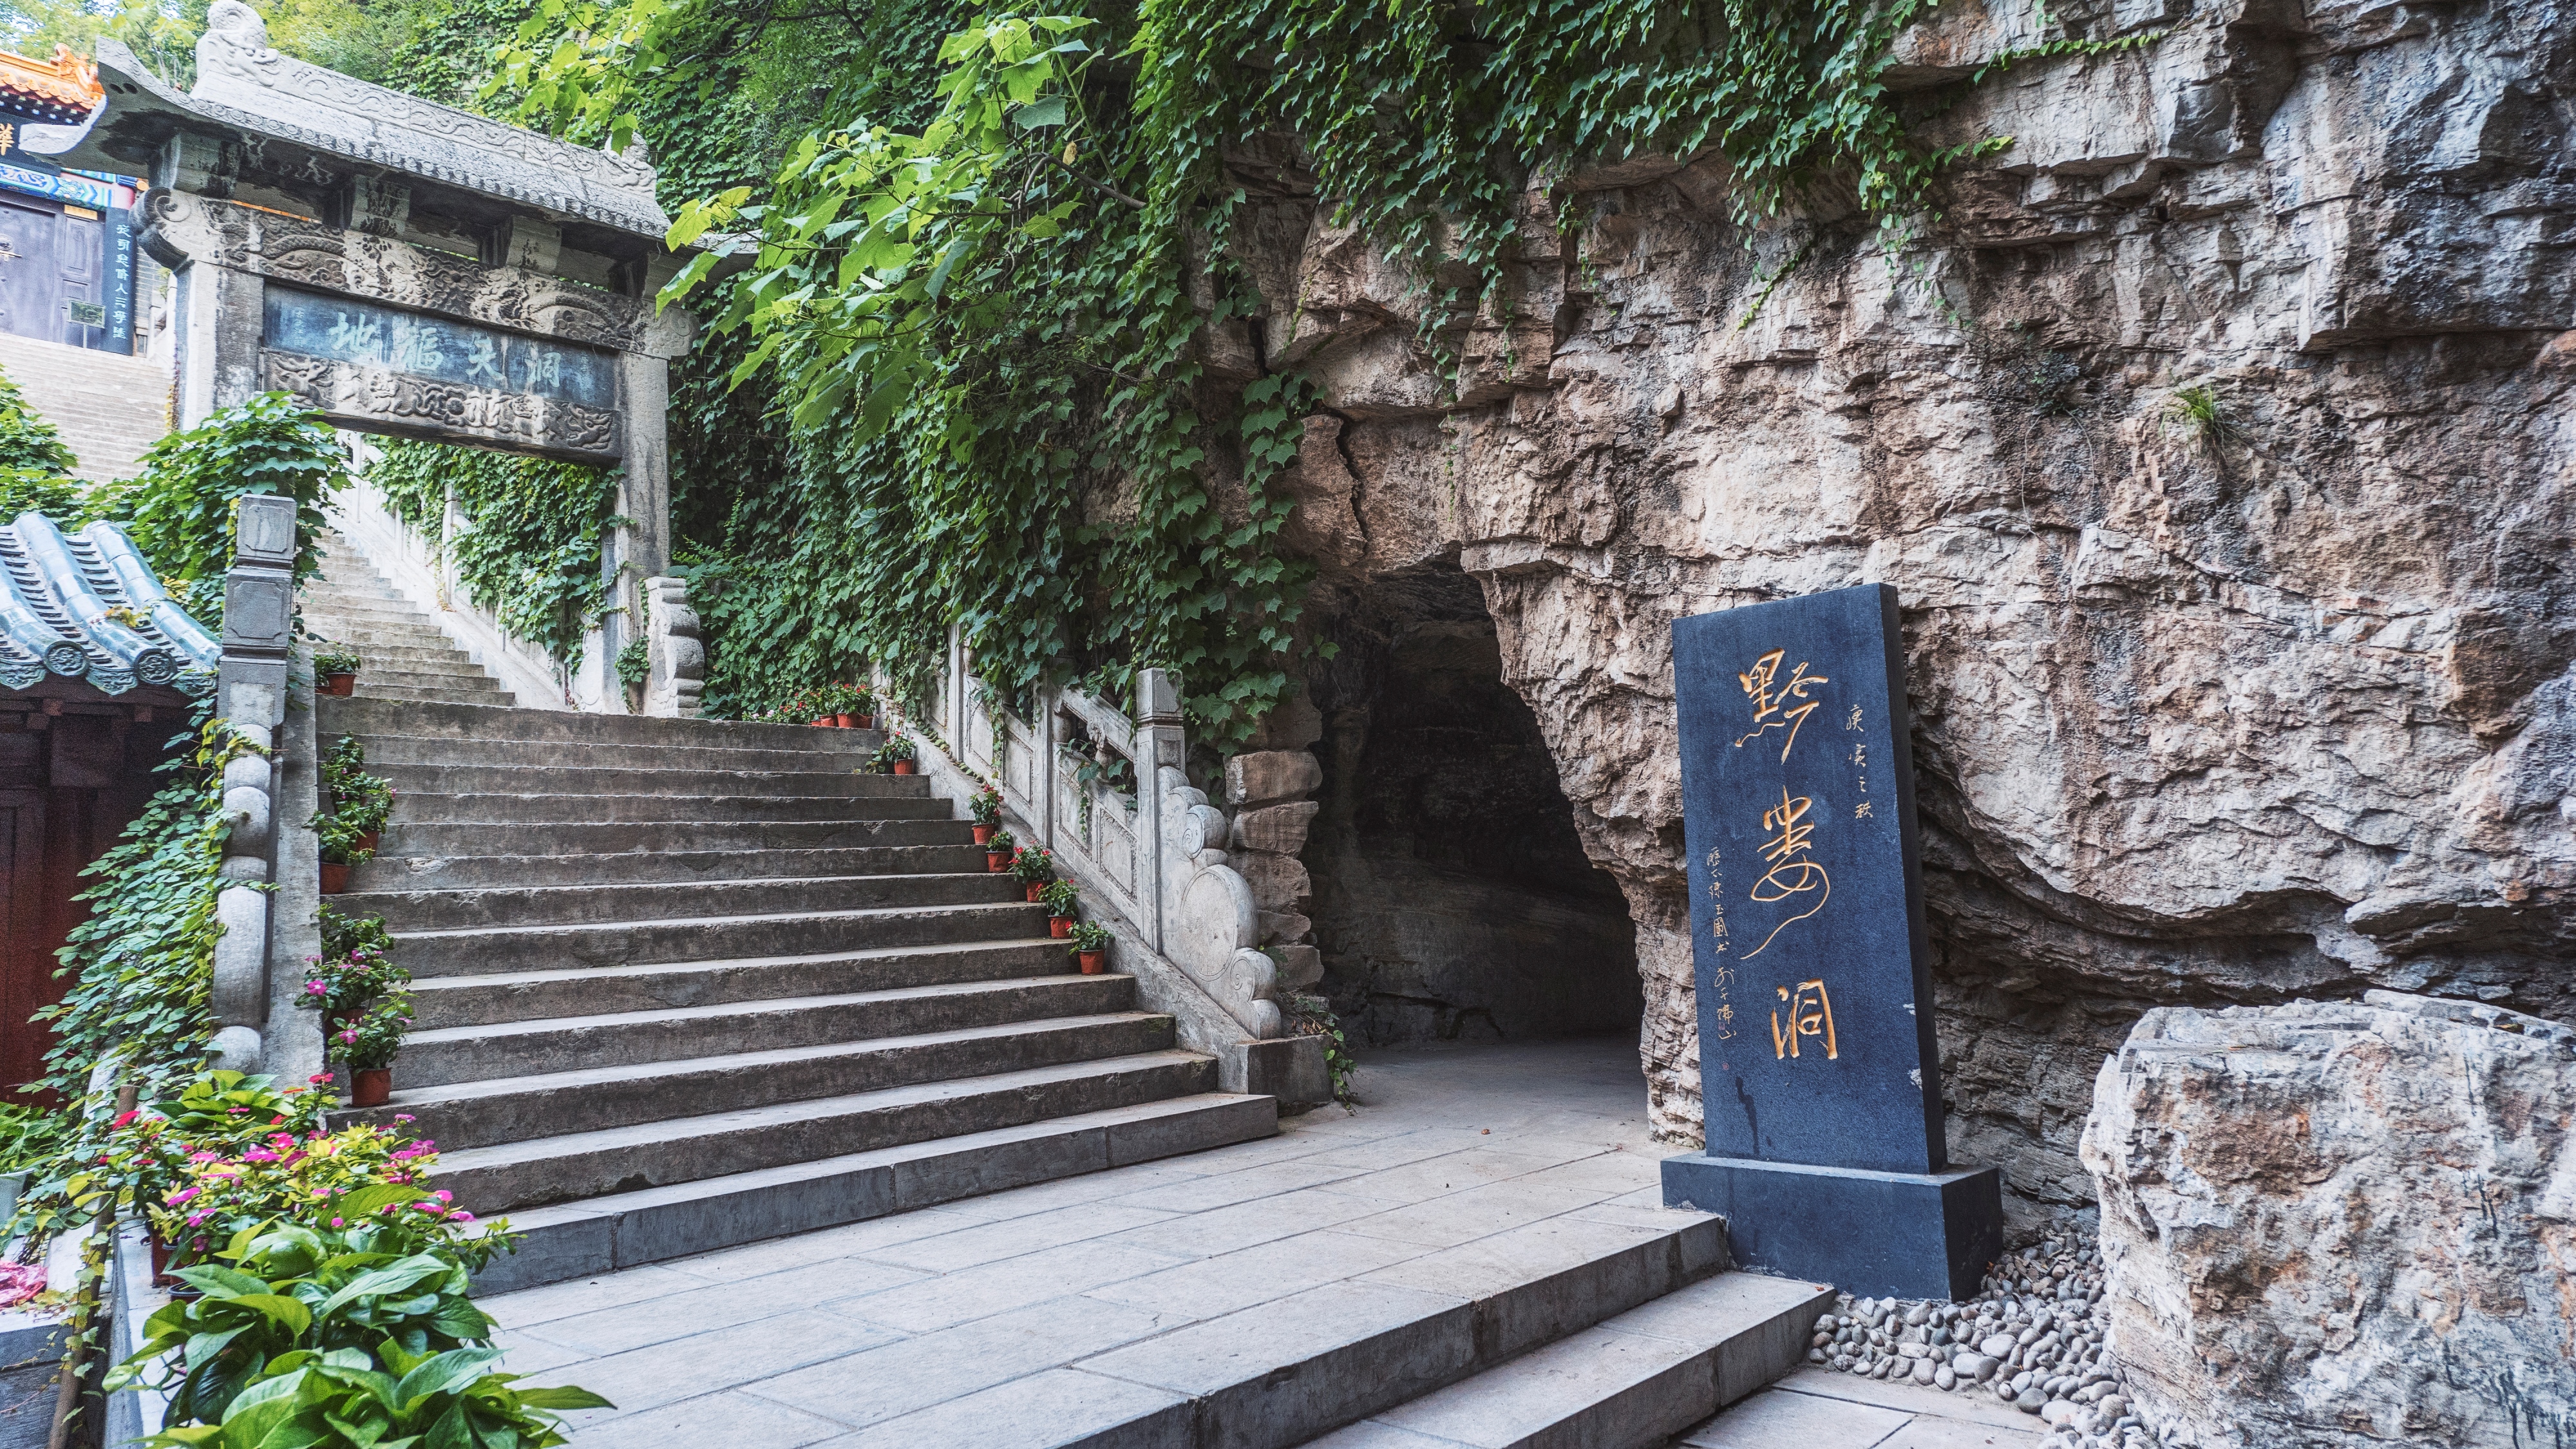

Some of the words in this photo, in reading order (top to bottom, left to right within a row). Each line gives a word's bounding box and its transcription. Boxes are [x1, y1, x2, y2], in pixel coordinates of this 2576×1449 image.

[327, 311, 562, 388] 洞天福地
[1846, 704, 1873, 819] 庚寅之秋
